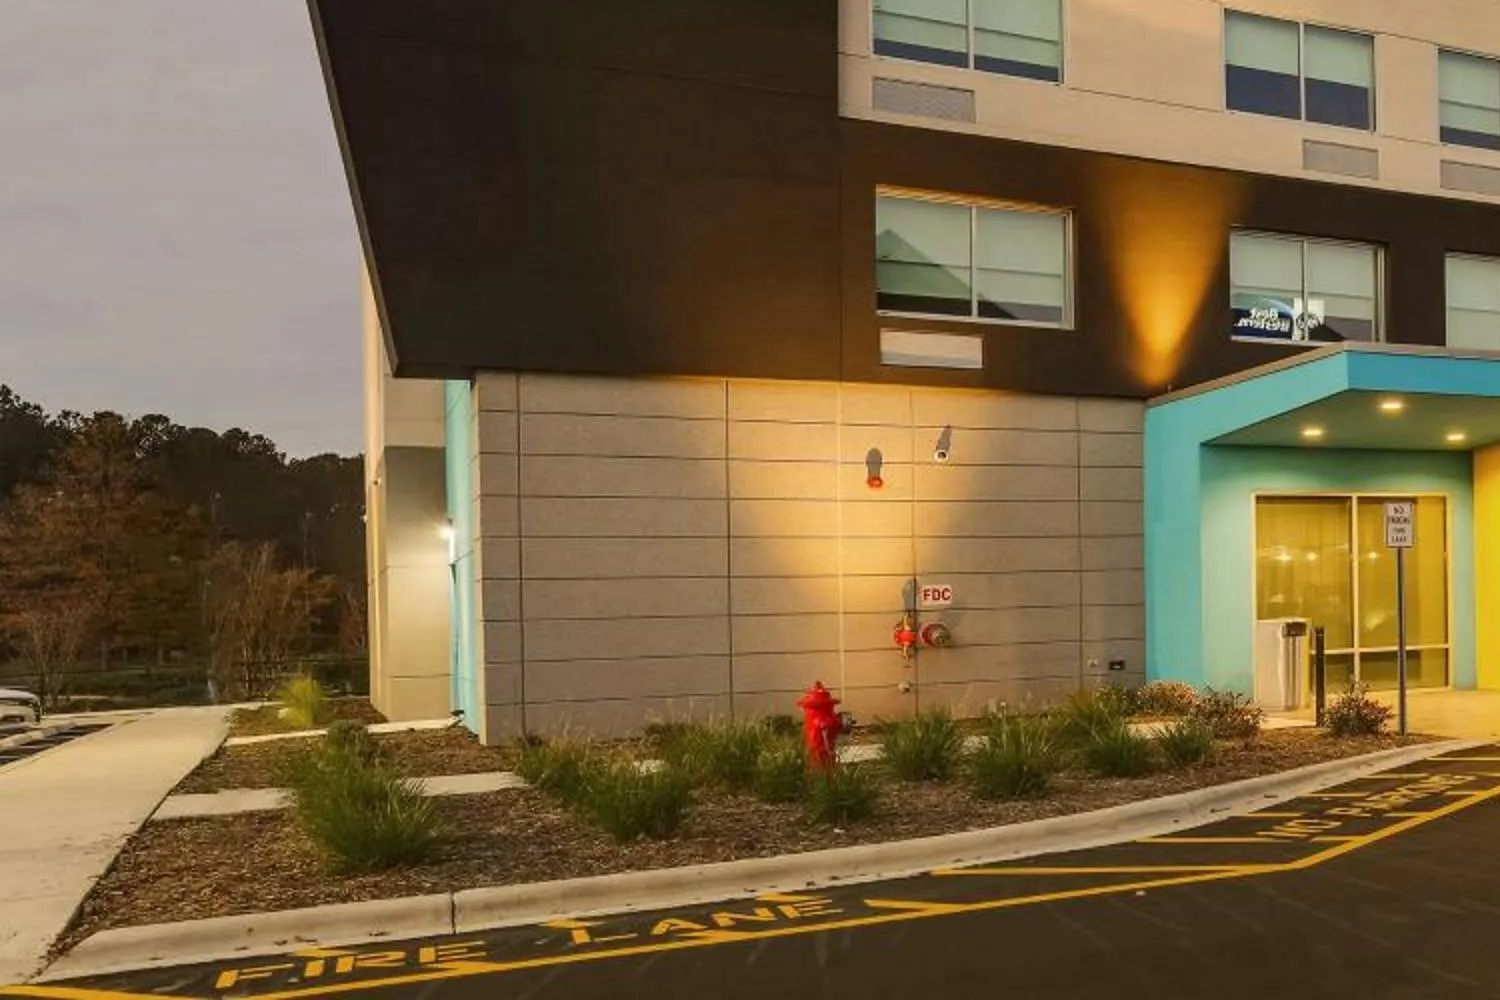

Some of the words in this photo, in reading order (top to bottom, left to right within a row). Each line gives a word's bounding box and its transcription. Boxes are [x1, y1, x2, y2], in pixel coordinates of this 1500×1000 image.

[923, 587, 951, 601] FDC
[1254, 818, 1343, 838] NO
[214, 940, 487, 989] FIRE
[569, 898, 844, 946] LANE
